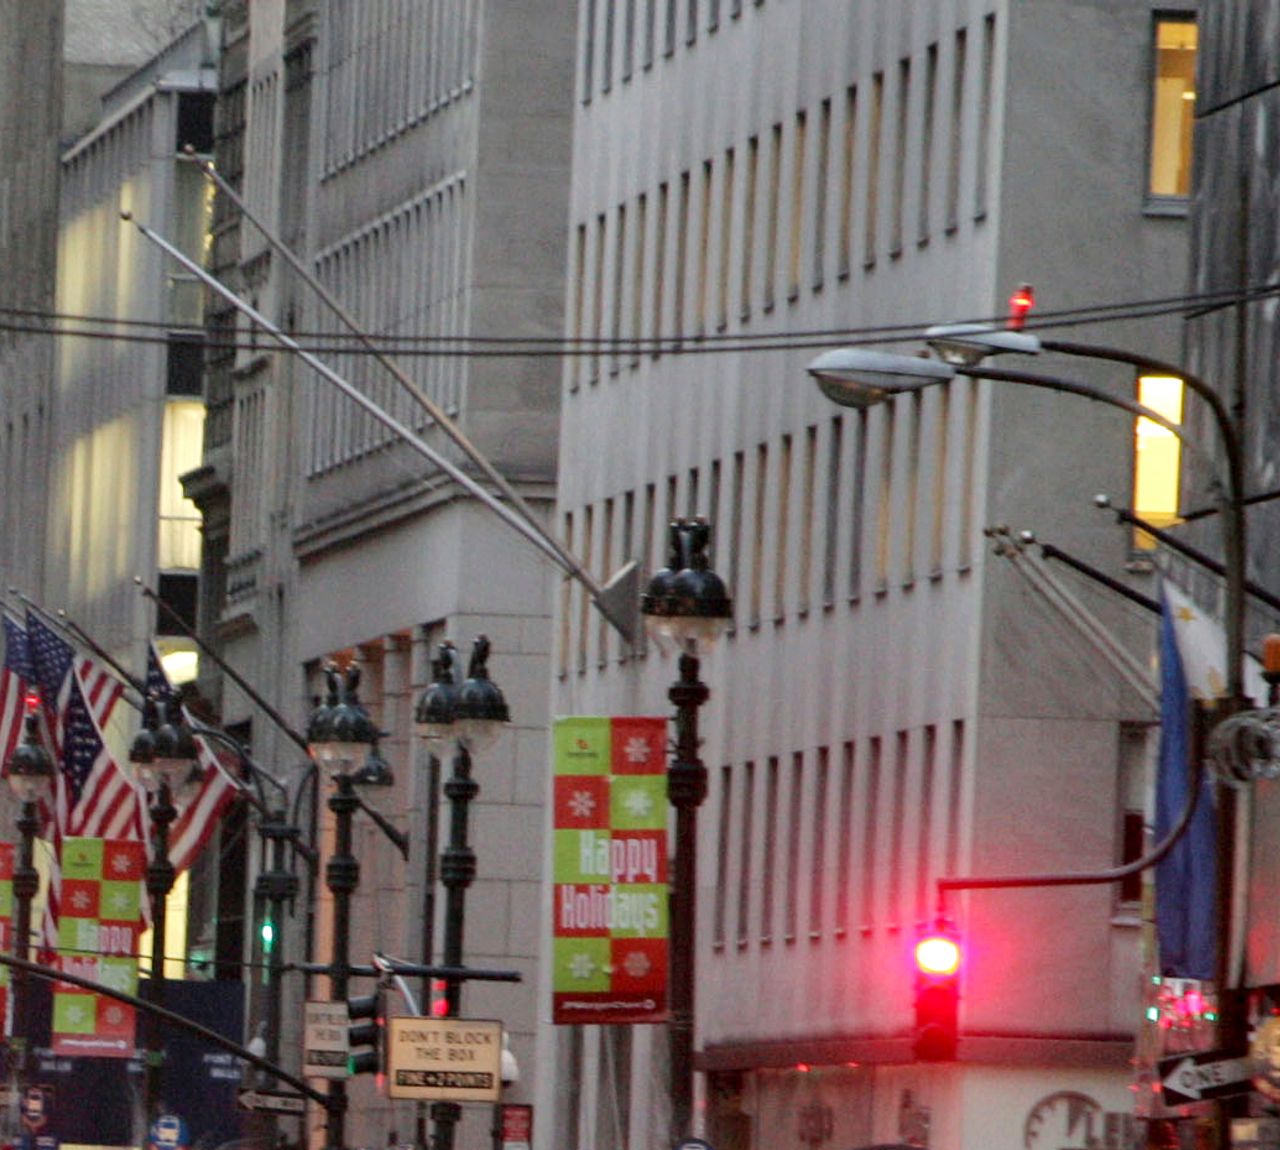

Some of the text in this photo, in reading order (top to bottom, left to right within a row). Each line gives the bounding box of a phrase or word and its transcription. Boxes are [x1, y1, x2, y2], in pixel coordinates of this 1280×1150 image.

[578, 830, 658, 884] Happy
[560, 883, 660, 938] Holidays
[399, 1029, 492, 1045] DON'T BLOCK
[415, 1047, 476, 1062] THE BOX
[1182, 1063, 1225, 1090] ONE
